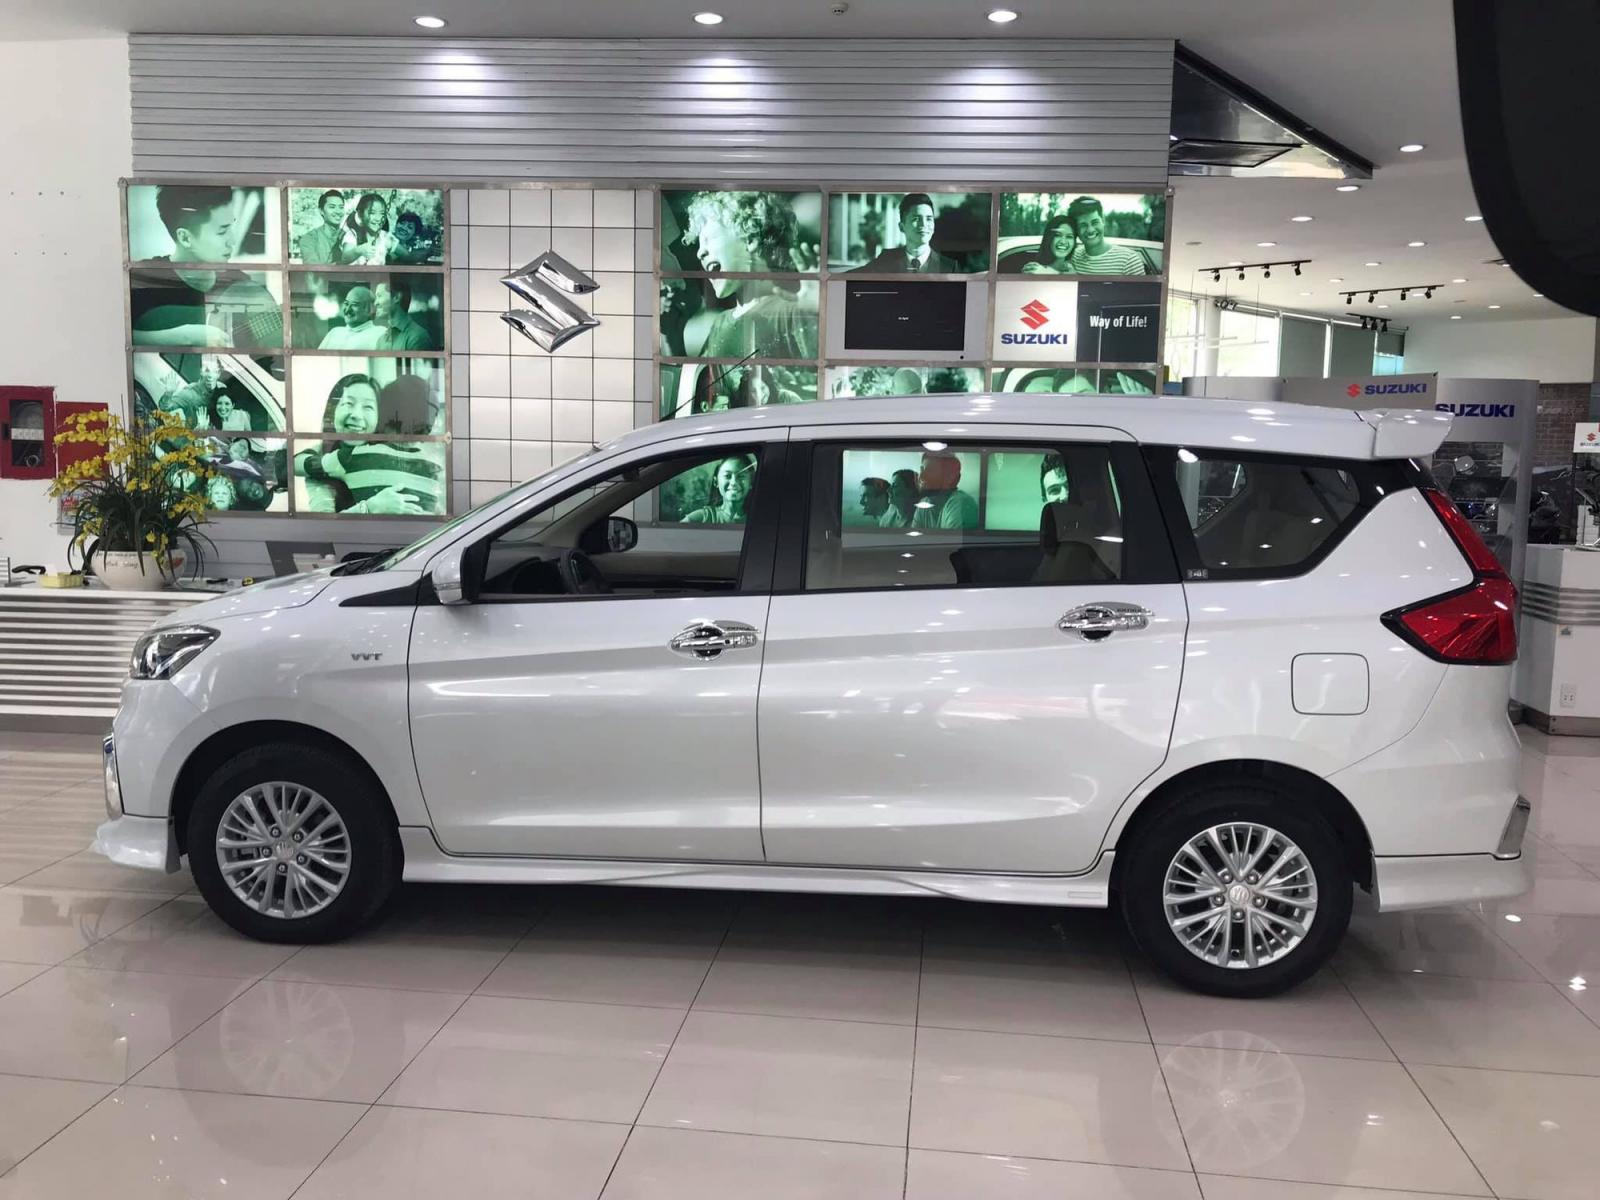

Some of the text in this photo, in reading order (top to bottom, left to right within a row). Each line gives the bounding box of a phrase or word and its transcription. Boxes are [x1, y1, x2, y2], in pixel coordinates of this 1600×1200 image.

[1089, 315, 1148, 330] Way of Life!
[1001, 333, 1068, 345] SUZUKI
[1364, 383, 1427, 395] SUZUKI
[1435, 403, 1515, 418] SUZUKI
[351, 652, 383, 661] VVT
